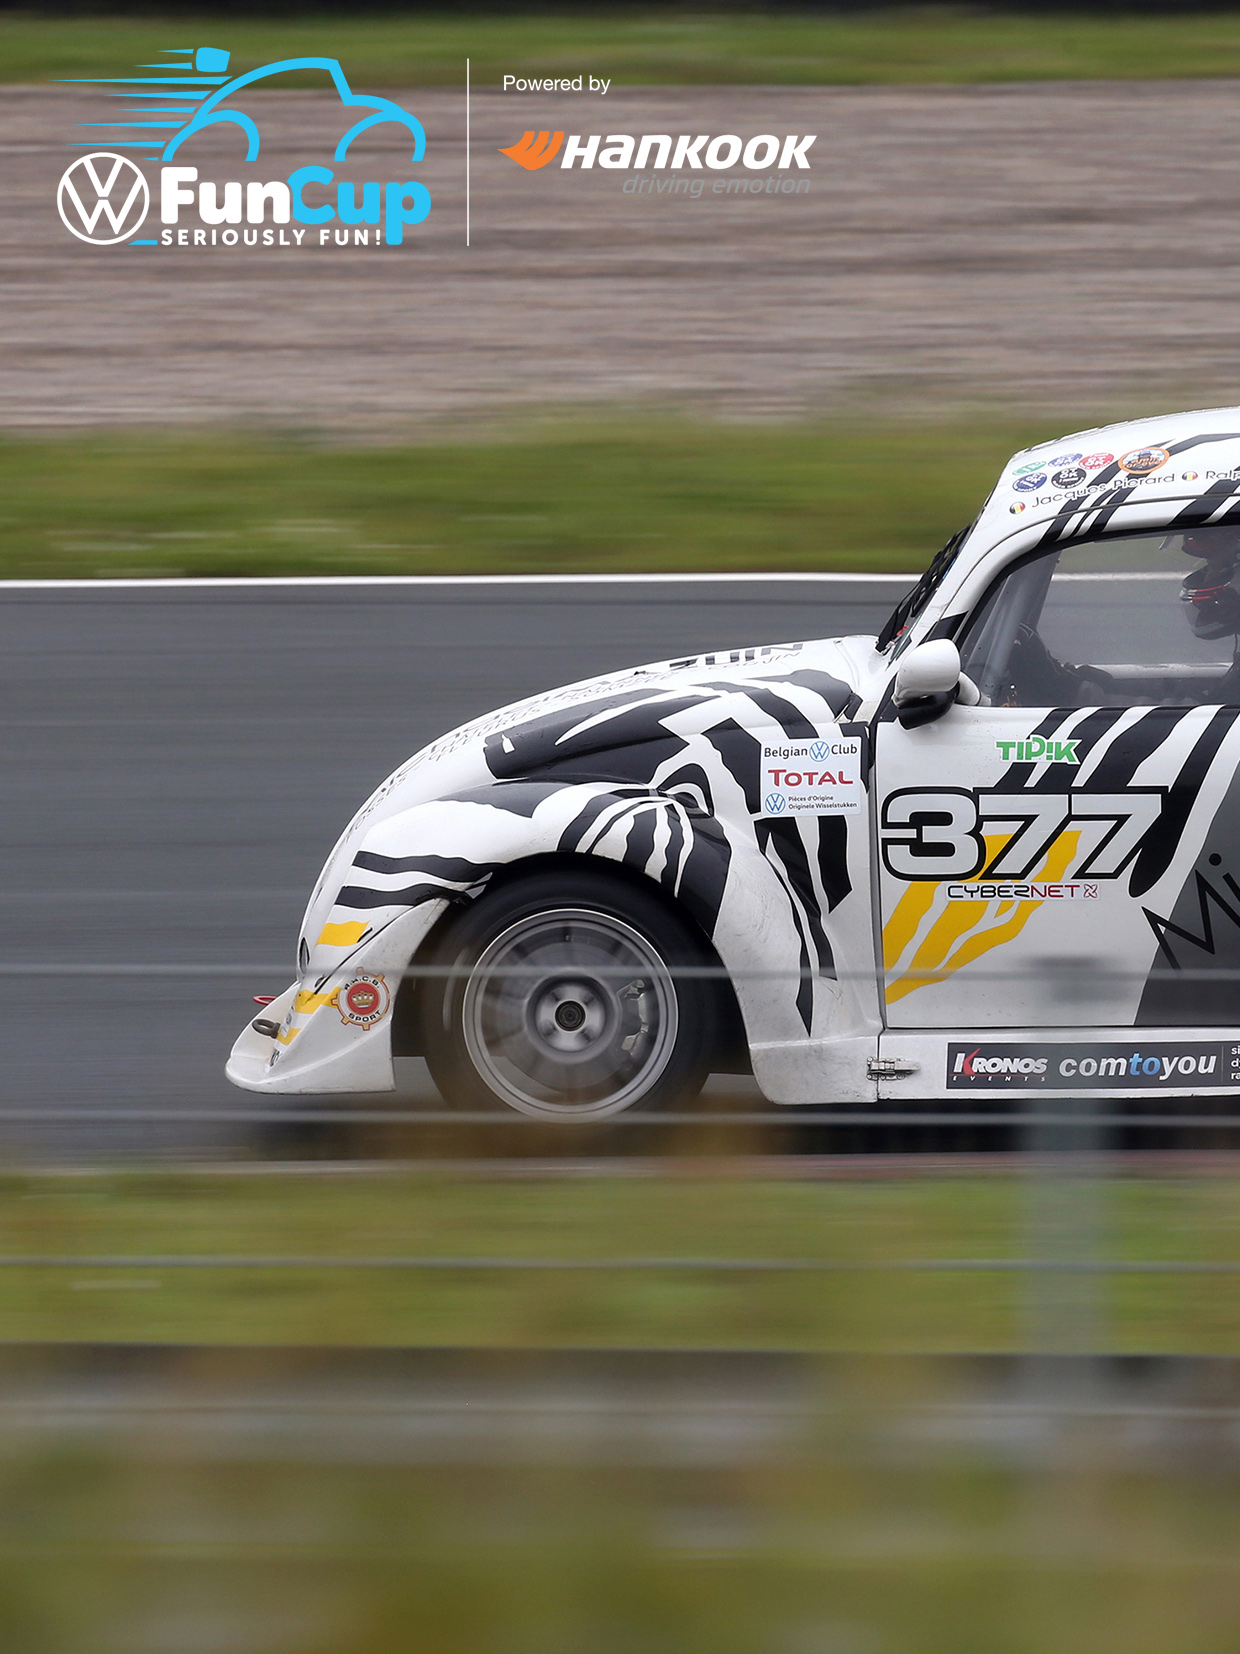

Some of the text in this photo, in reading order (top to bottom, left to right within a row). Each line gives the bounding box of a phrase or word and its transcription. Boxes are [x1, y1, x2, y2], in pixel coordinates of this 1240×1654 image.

[1031, 482, 1107, 508] Jacques
[1113, 472, 1175, 489] Pierard
[764, 746, 808, 760] Belgian
[831, 744, 858, 755] Club
[768, 769, 853, 787] TOTAL
[881, 786, 1169, 881] 377
[348, 1010, 381, 1022] SPORT
[953, 1048, 1049, 1074] KRONOS
[1059, 1052, 1216, 1081] comtoyou
